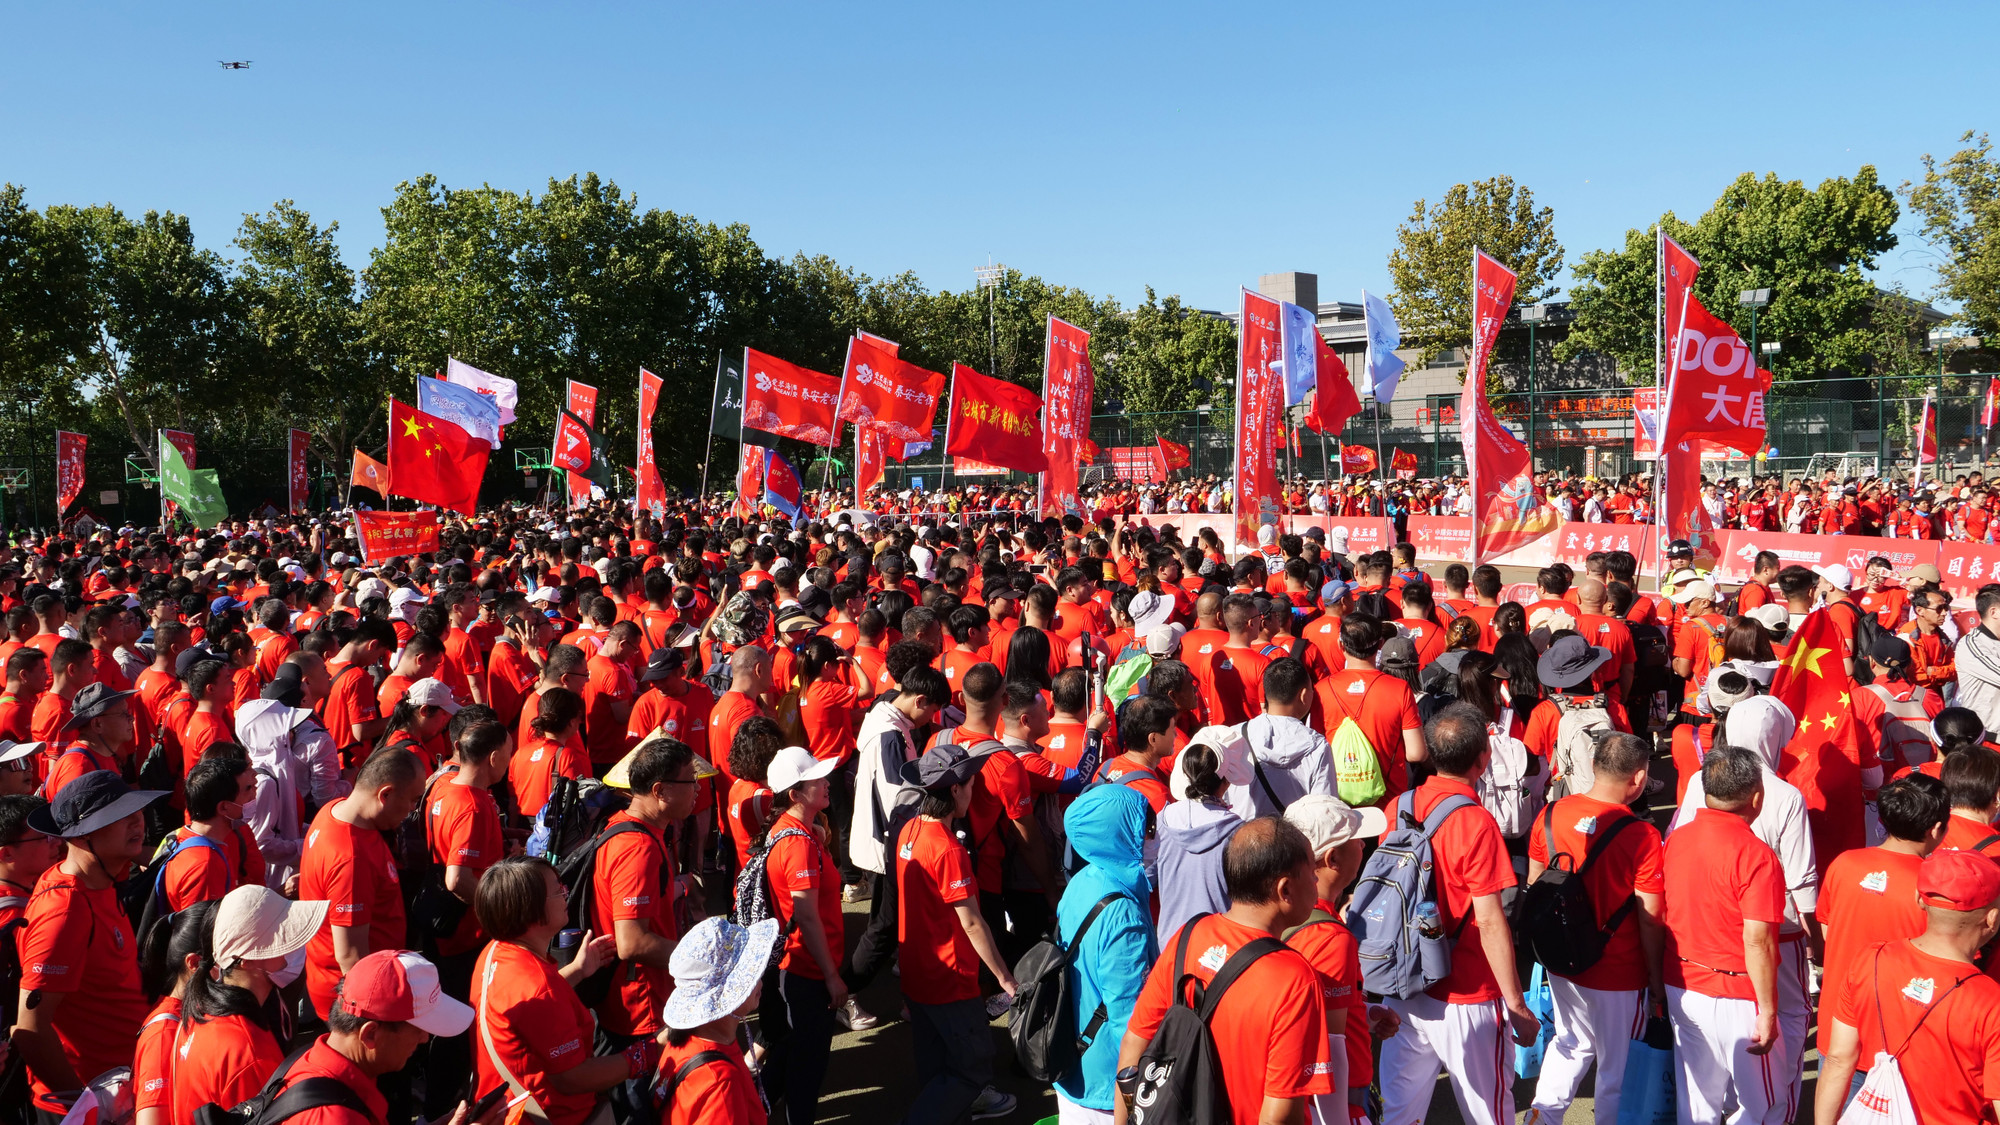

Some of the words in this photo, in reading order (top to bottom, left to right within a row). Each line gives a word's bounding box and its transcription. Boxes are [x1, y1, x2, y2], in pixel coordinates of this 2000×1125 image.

[721, 387, 742, 409] 泰山
[801, 387, 839, 405] 泰安老街
[1416, 405, 1456, 426] 门诊
[1241, 366, 1259, 497] 畅享国泰民安
[1565, 531, 1630, 552] 登高望远
